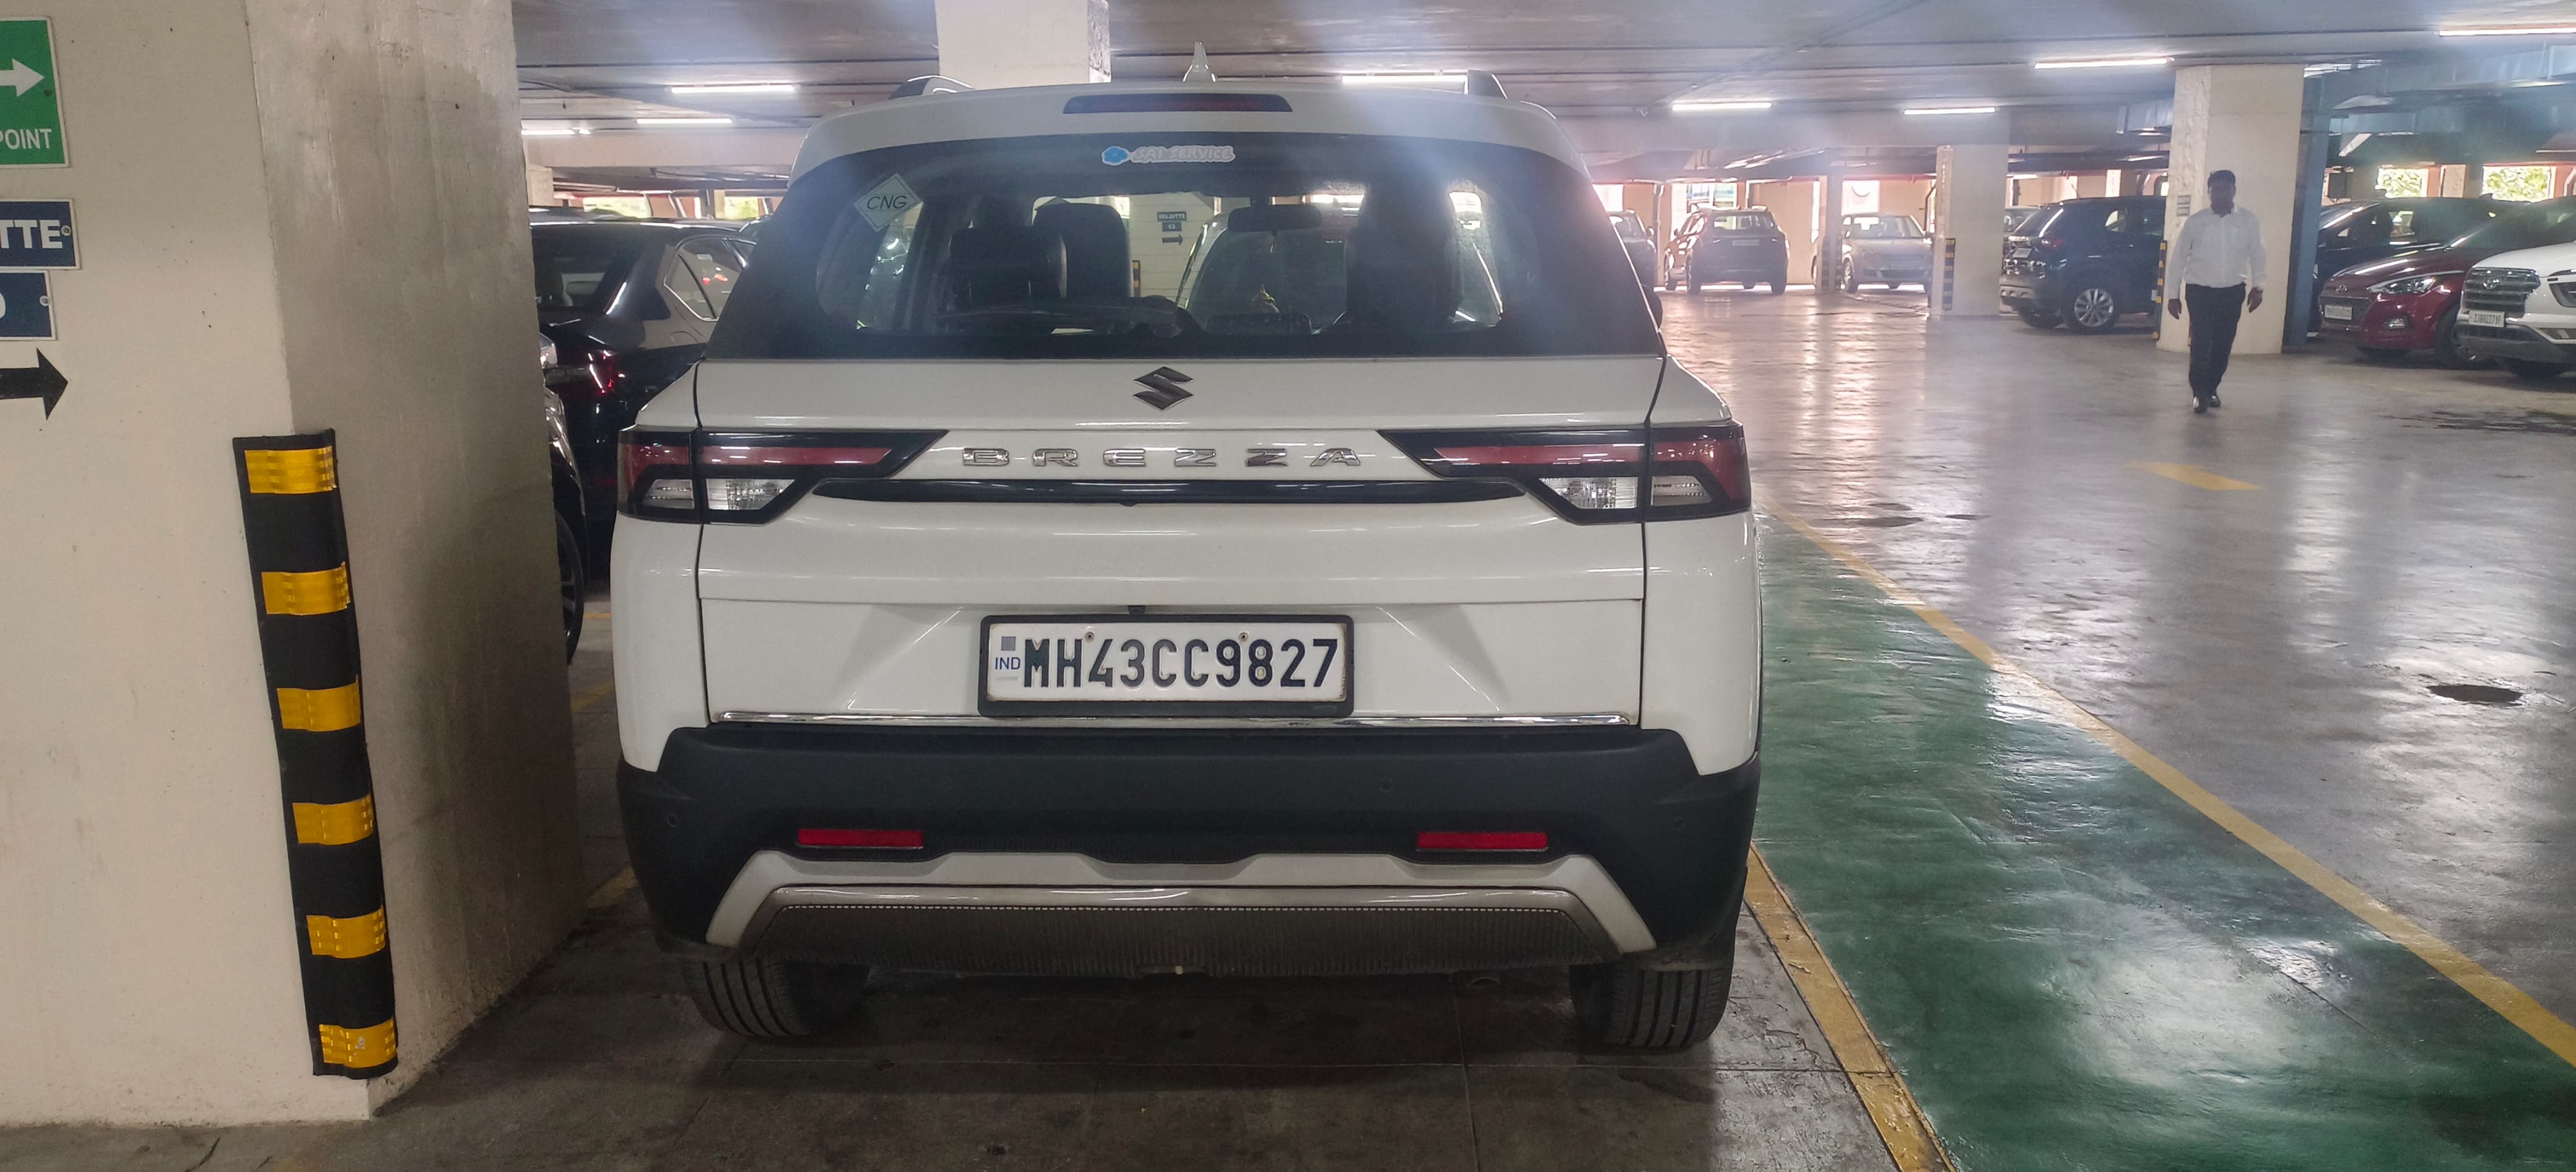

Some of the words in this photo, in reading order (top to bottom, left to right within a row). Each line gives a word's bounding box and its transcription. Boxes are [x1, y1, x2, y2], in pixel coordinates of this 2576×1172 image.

[1135, 147, 1164, 161] SAI
[1169, 146, 1231, 161] SERVICE
[867, 195, 907, 209] CNG
[962, 448, 1361, 467] BREZZA
[995, 657, 1020, 670] IND
[1024, 639, 1338, 689] MH43CC9827
